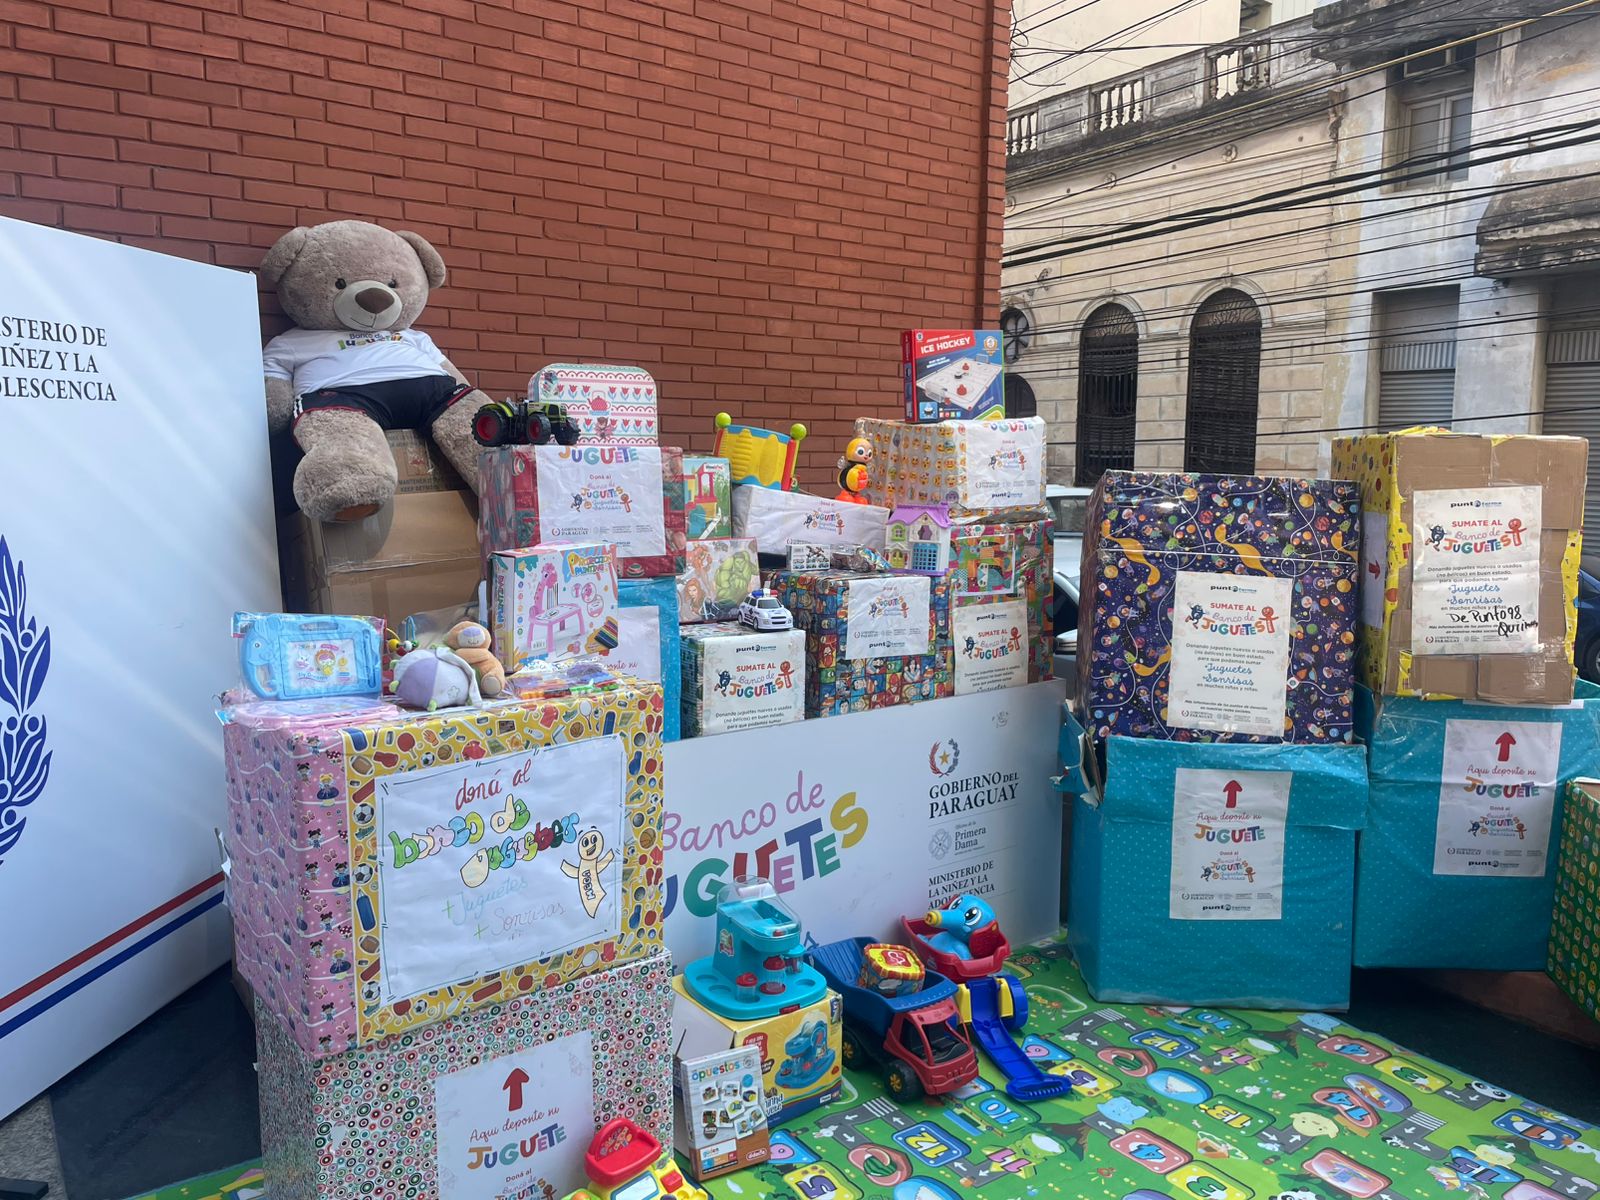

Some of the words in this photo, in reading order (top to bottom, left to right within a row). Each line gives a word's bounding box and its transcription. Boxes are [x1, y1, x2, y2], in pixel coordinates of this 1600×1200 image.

[82, 325, 108, 347] DE
[921, 344, 935, 354] ICE
[936, 337, 971, 351] HOCKEY
[56, 351, 69, 372] Y
[73, 353, 99, 374] LA
[559, 446, 639, 465] JUGUETE
[1452, 520, 1488, 528] SUMATE
[1455, 531, 1487, 541] Banco
[1489, 527, 1500, 536] de
[1443, 534, 1511, 554] JUGUETES
[1210, 602, 1244, 611] SUMATE
[1201, 617, 1265, 635] JUGUETES
[1213, 612, 1242, 623] Banco
[1244, 612, 1255, 621] de
[1446, 613, 1469, 623] De
[974, 641, 1014, 660] JUGUETES
[736, 664, 765, 672] SUMATE
[738, 675, 764, 685] Banco
[766, 670, 775, 680] de
[729, 678, 783, 698] JUGUETES
[455, 769, 502, 811] doná
[512, 759, 532, 786] al
[929, 771, 1002, 799] GOBIERNO
[1003, 772, 1019, 783] DEL
[1464, 776, 1540, 798] JUGUETE
[662, 802, 776, 852] Banco
[786, 770, 825, 815] de
[929, 783, 1019, 819] PARAGUAY
[388, 811, 484, 868] banco
[490, 793, 531, 833] de
[955, 827, 986, 841] Primera
[1194, 823, 1266, 844] JUGUETE
[955, 839, 978, 851] Dama
[928, 864, 981, 887] MINISTERIO
[982, 860, 994, 871] DE
[928, 885, 940, 898] LA
[941, 878, 969, 895] NIÑEZ
[970, 876, 977, 887] Y
[977, 874, 988, 885] LA
[691, 1061, 741, 1083] opuestos
[467, 1123, 567, 1169] JUGUETE
[506, 1171, 524, 1182] Doná
